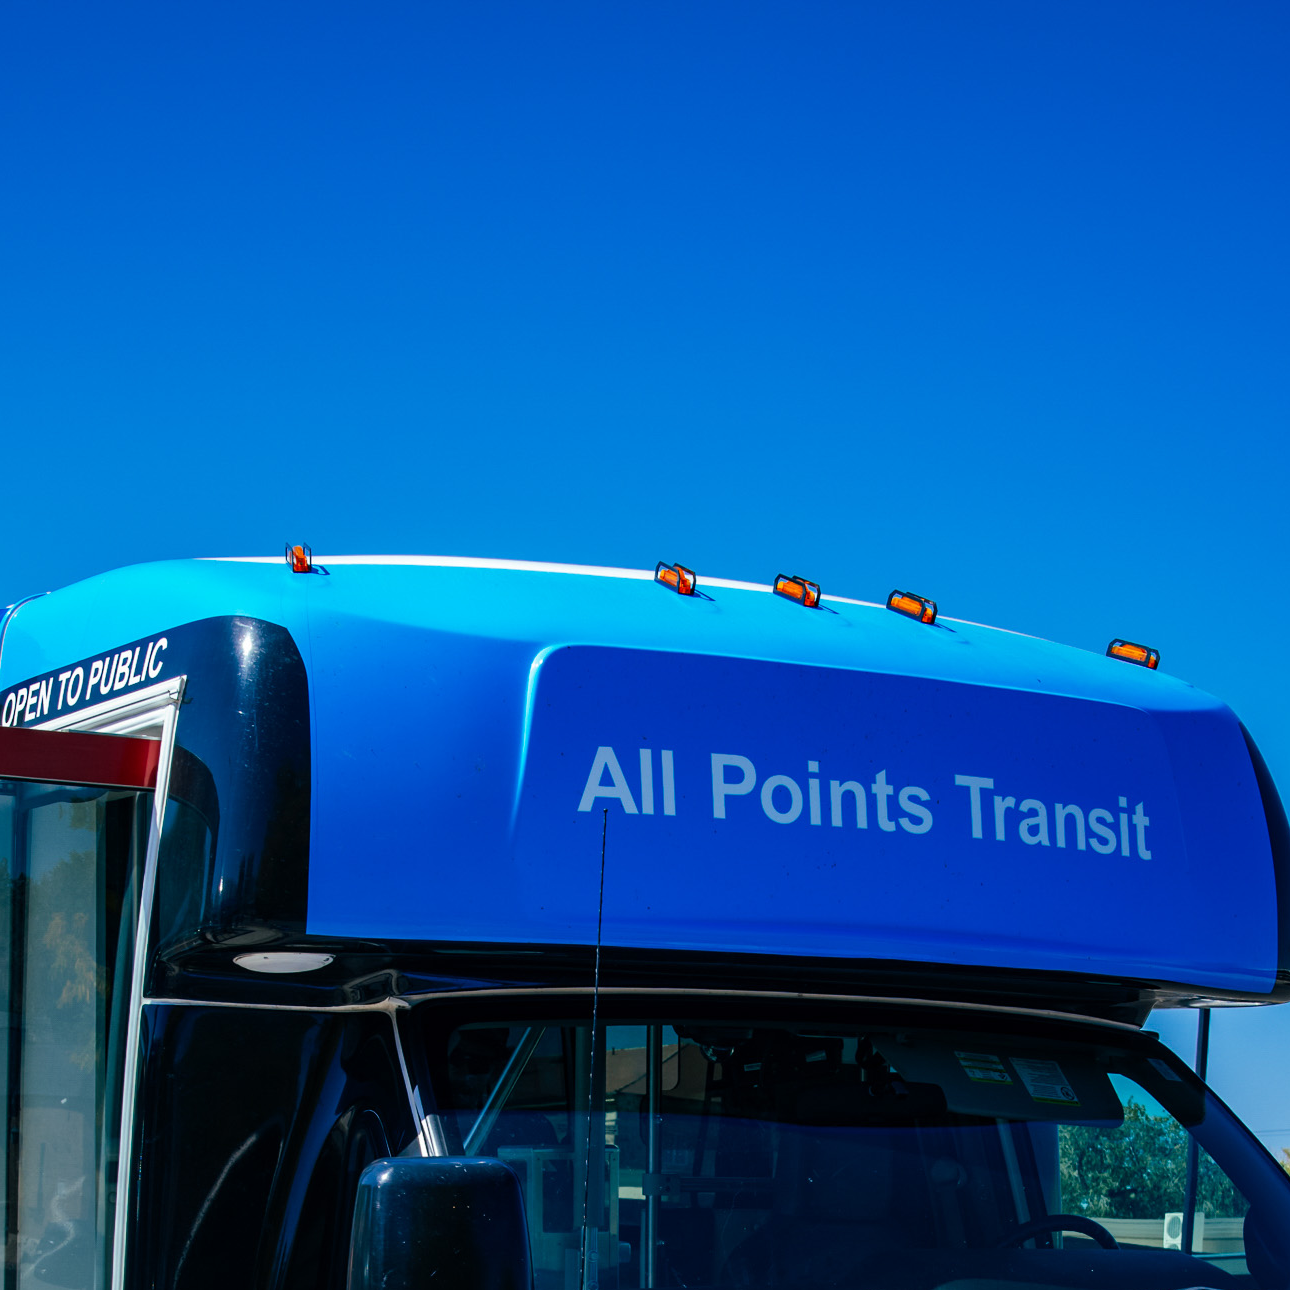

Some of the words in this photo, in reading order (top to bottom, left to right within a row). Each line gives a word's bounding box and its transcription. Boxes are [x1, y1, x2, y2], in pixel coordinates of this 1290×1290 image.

[1, 677, 54, 727] OPEN
[57, 666, 85, 711] TO
[85, 637, 168, 700] PUBLIC
[577, 745, 677, 816] All
[710, 752, 935, 835] Points
[954, 774, 1153, 861] Transit
